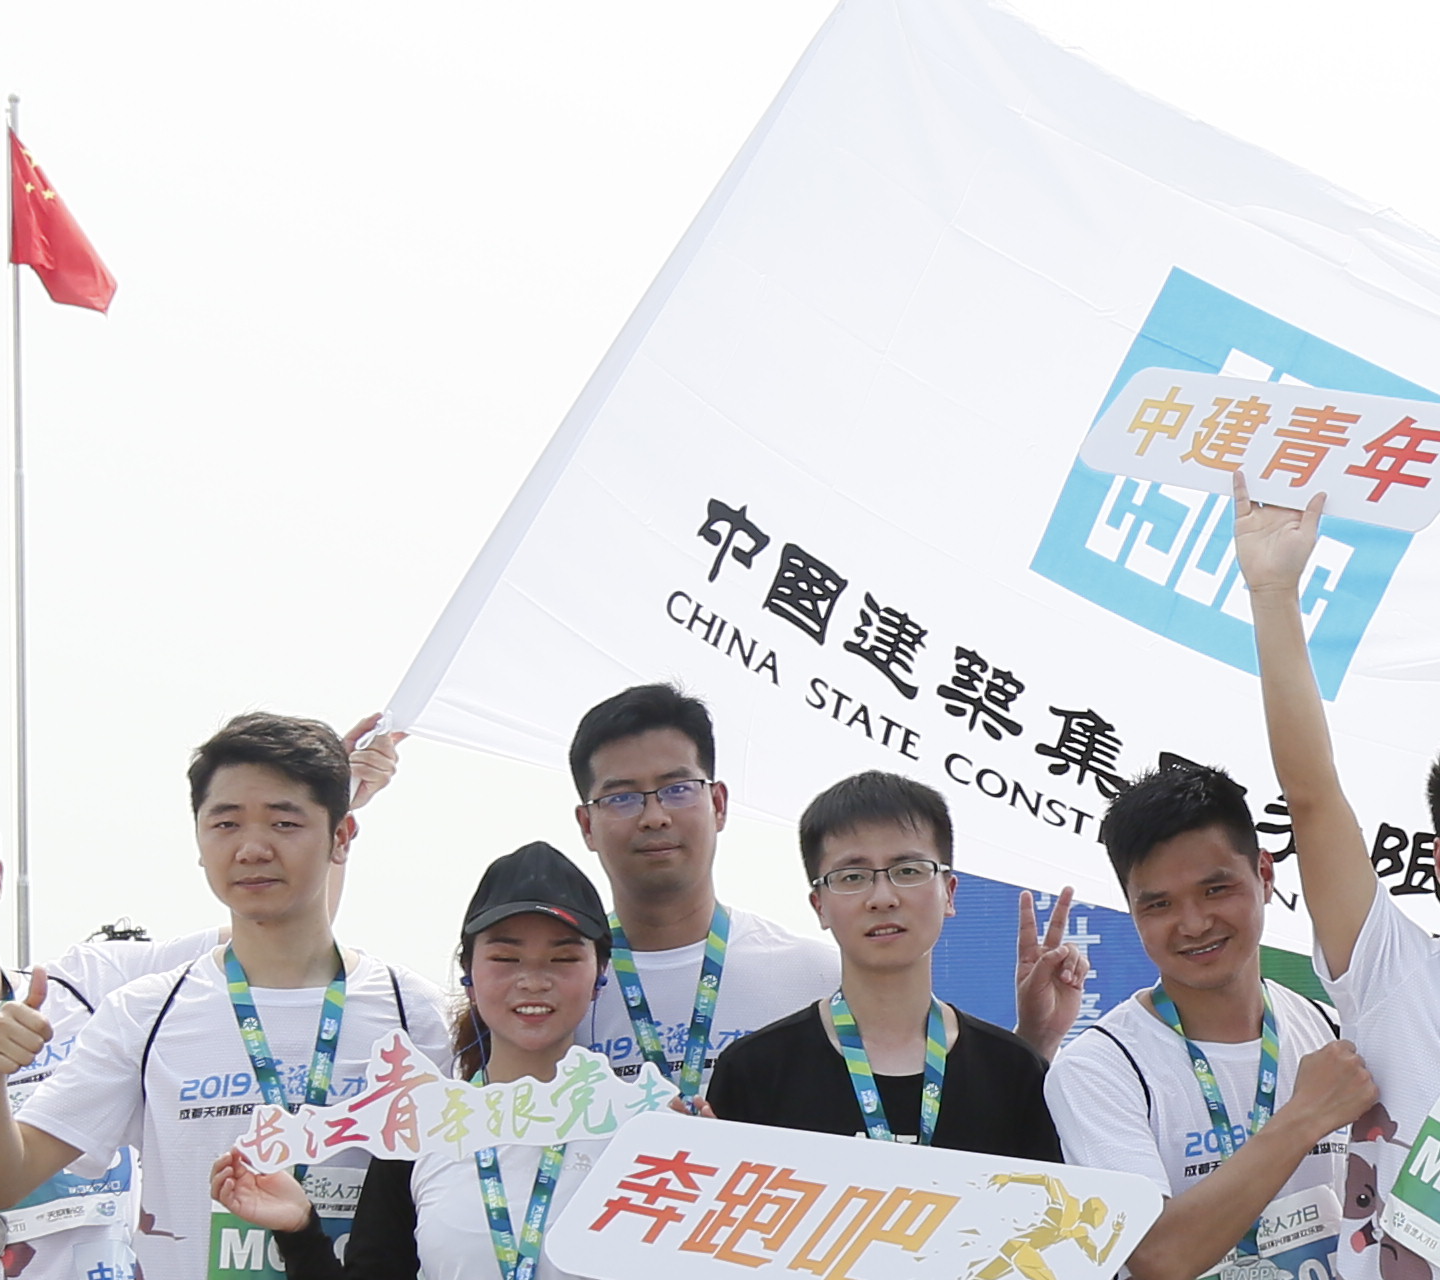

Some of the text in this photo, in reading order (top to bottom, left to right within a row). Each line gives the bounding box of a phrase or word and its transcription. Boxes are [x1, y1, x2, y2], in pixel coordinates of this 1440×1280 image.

[666, 590, 1106, 844] CHINA STATE CONST
